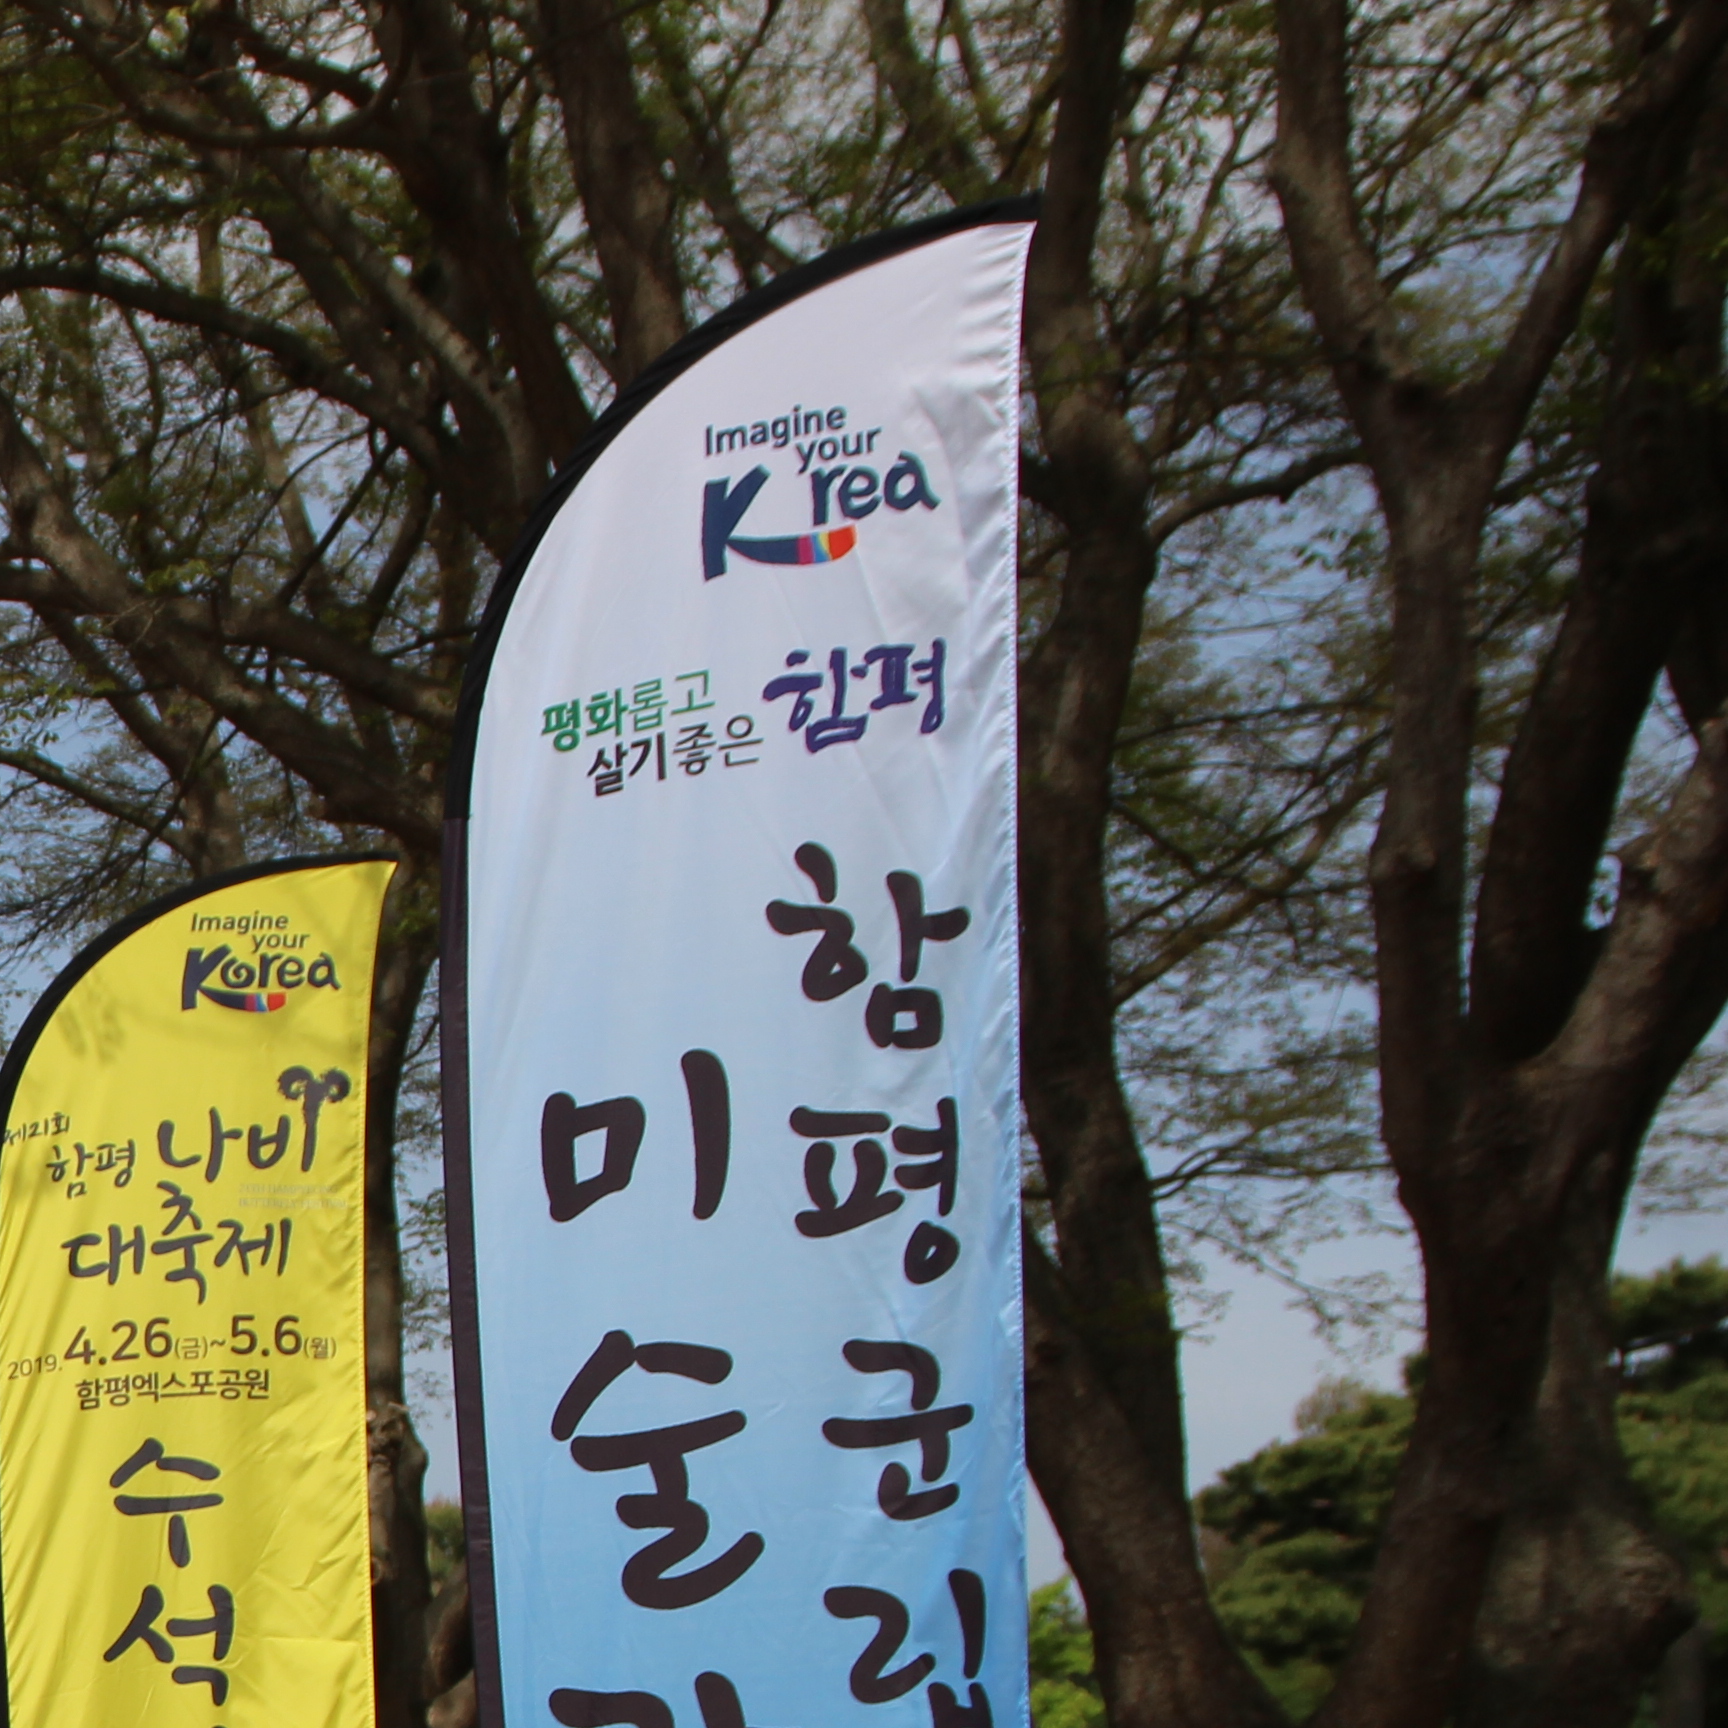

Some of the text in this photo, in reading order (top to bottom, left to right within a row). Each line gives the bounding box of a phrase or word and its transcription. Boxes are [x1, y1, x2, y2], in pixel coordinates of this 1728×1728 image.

[704, 404, 847, 457] Imagine
[795, 426, 882, 474] your
[541, 669, 717, 752] 평화롭고
[760, 638, 946, 754] 함평
[586, 713, 765, 797] 살기좋은
[190, 910, 289, 934] Imagine
[251, 930, 310, 954] your
[180, 942, 341, 1012] Korea
[46, 1095, 322, 1198] 함평 나비
[60, 1180, 292, 1305] 대축제
[74, 1368, 271, 1411] 함평엑스포공원
